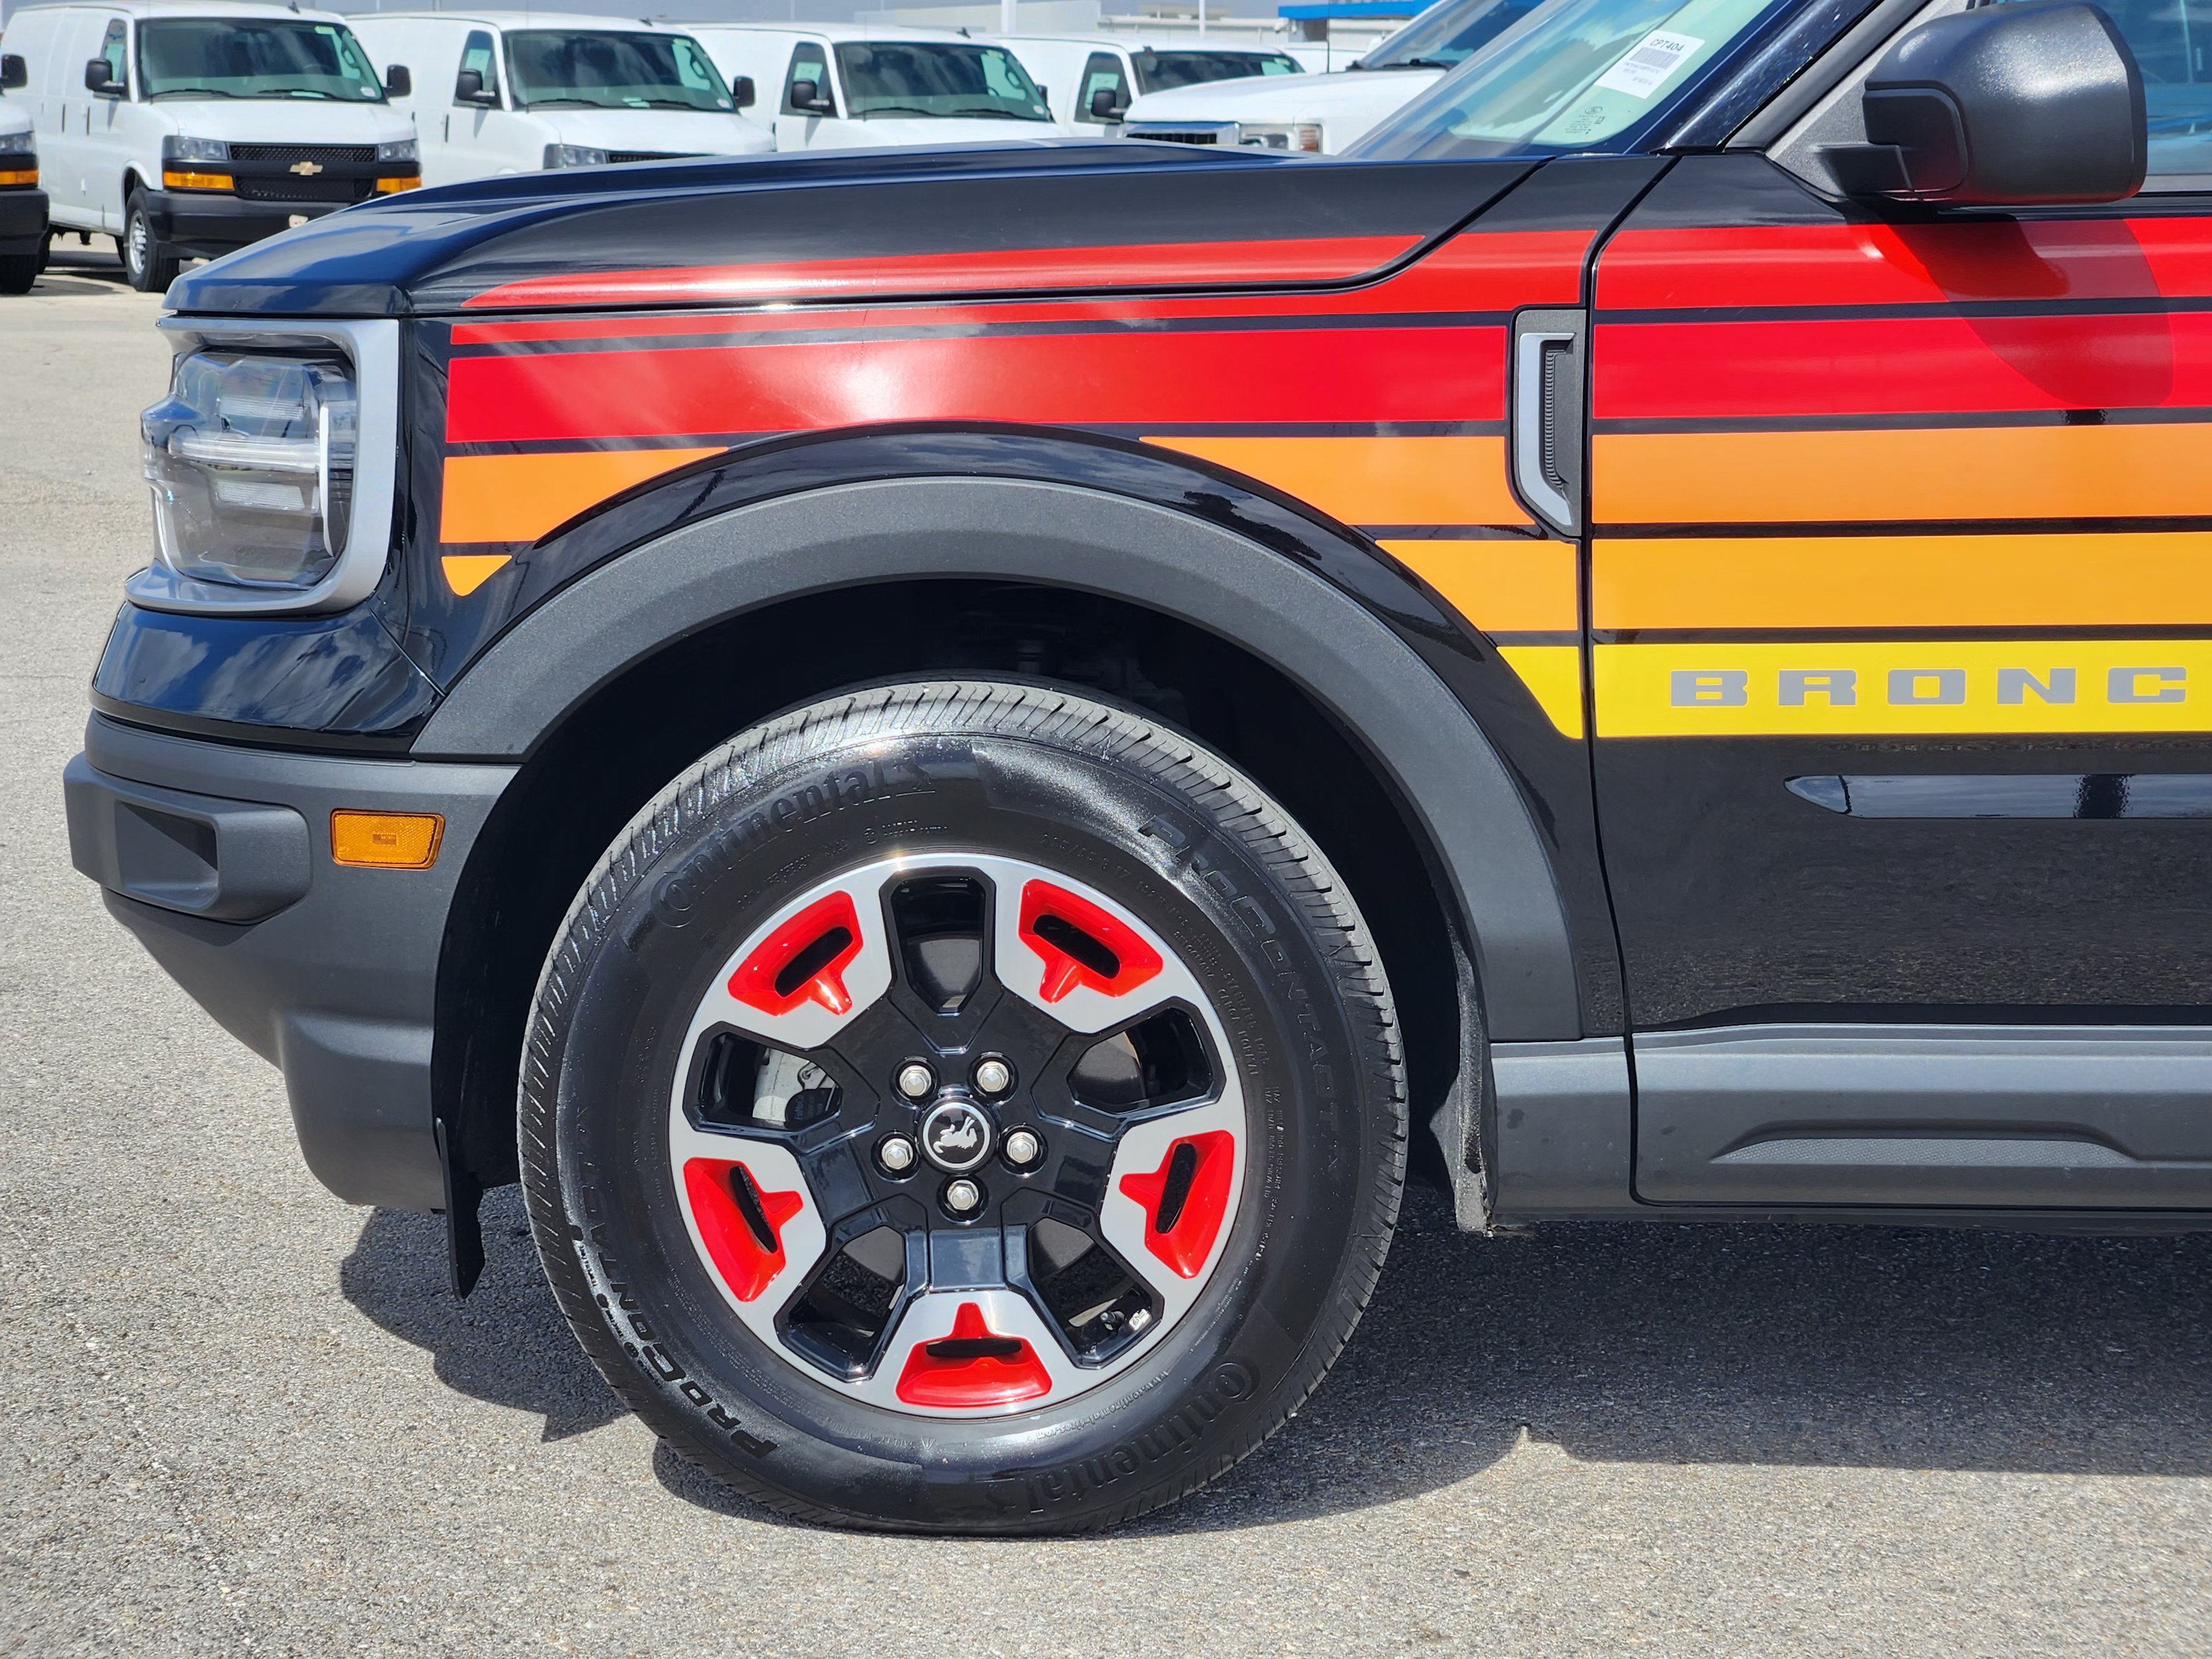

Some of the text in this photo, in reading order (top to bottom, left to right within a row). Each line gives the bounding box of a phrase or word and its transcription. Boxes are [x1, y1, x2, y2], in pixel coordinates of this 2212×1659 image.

[1650, 39, 1685, 51] CP7404
[1670, 666, 2187, 707] BRONC
[649, 758, 891, 928] Continental
[1022, 1357, 1262, 1514] Continental
